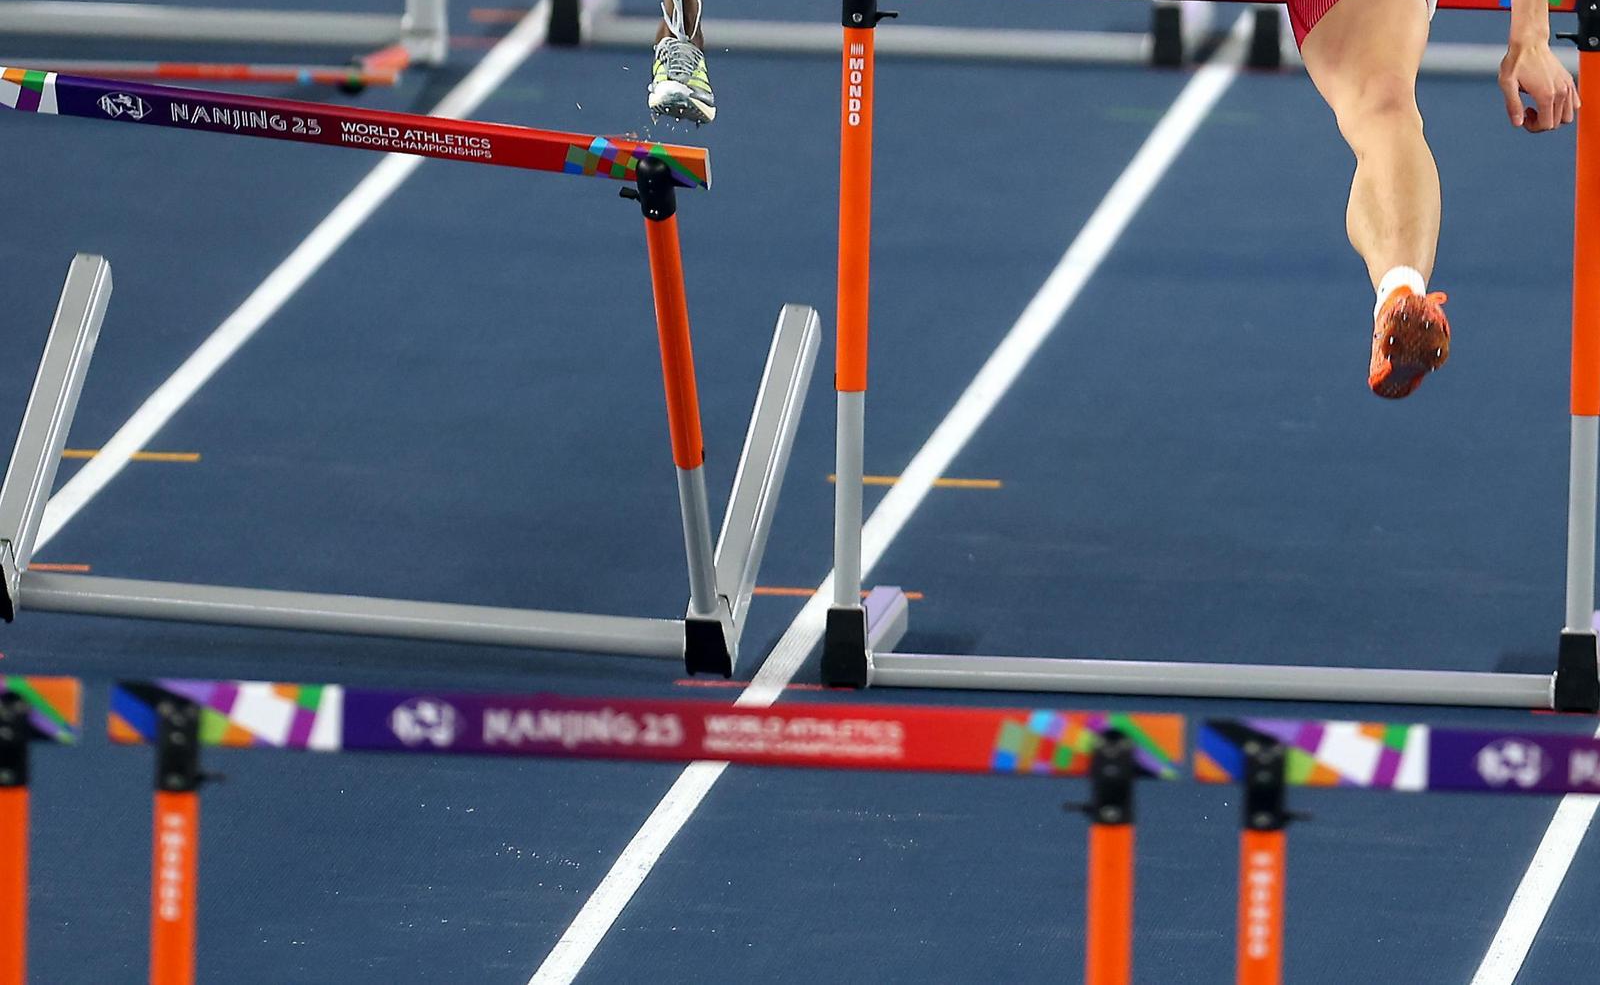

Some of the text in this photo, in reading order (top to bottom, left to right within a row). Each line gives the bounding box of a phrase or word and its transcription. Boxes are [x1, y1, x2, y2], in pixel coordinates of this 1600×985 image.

[848, 57, 865, 126] MONDO
[170, 102, 322, 136] NANJING 25
[340, 120, 491, 150] WORLD ATHLETICS
[341, 133, 493, 159] INDOOR CHAMPIONSHIPS
